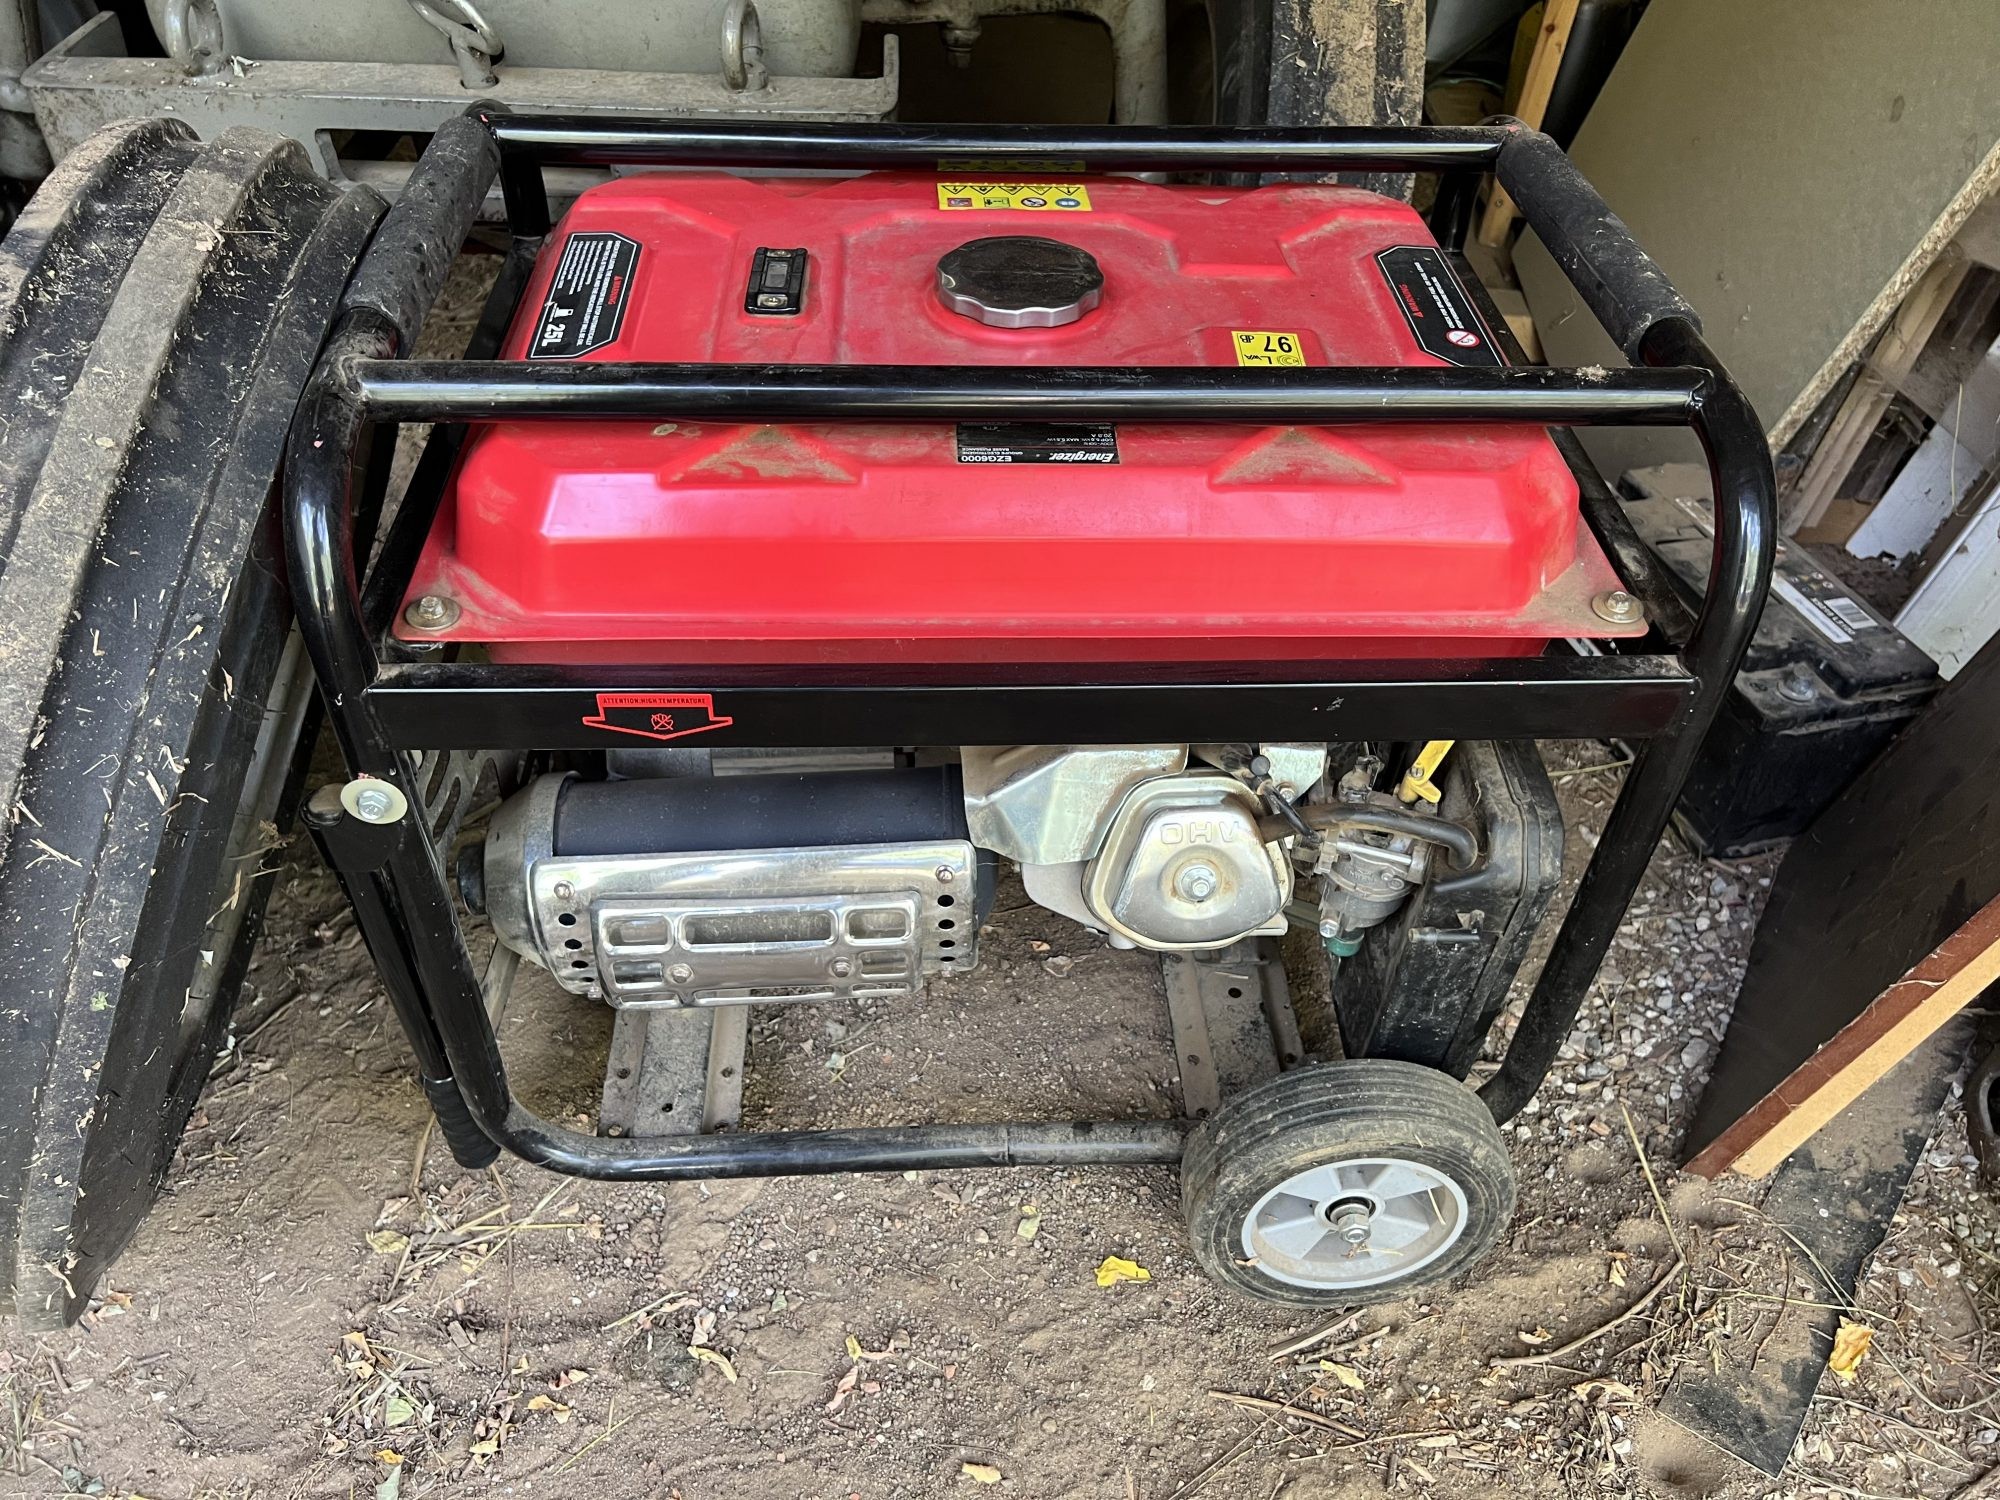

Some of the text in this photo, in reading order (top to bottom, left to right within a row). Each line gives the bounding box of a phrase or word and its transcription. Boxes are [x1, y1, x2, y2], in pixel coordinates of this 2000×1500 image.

[1400, 284, 1420, 311] WARNING
[542, 324, 565, 346] 25L
[1240, 335, 1292, 353] 97 dB
[1160, 822, 1239, 844] OHV
